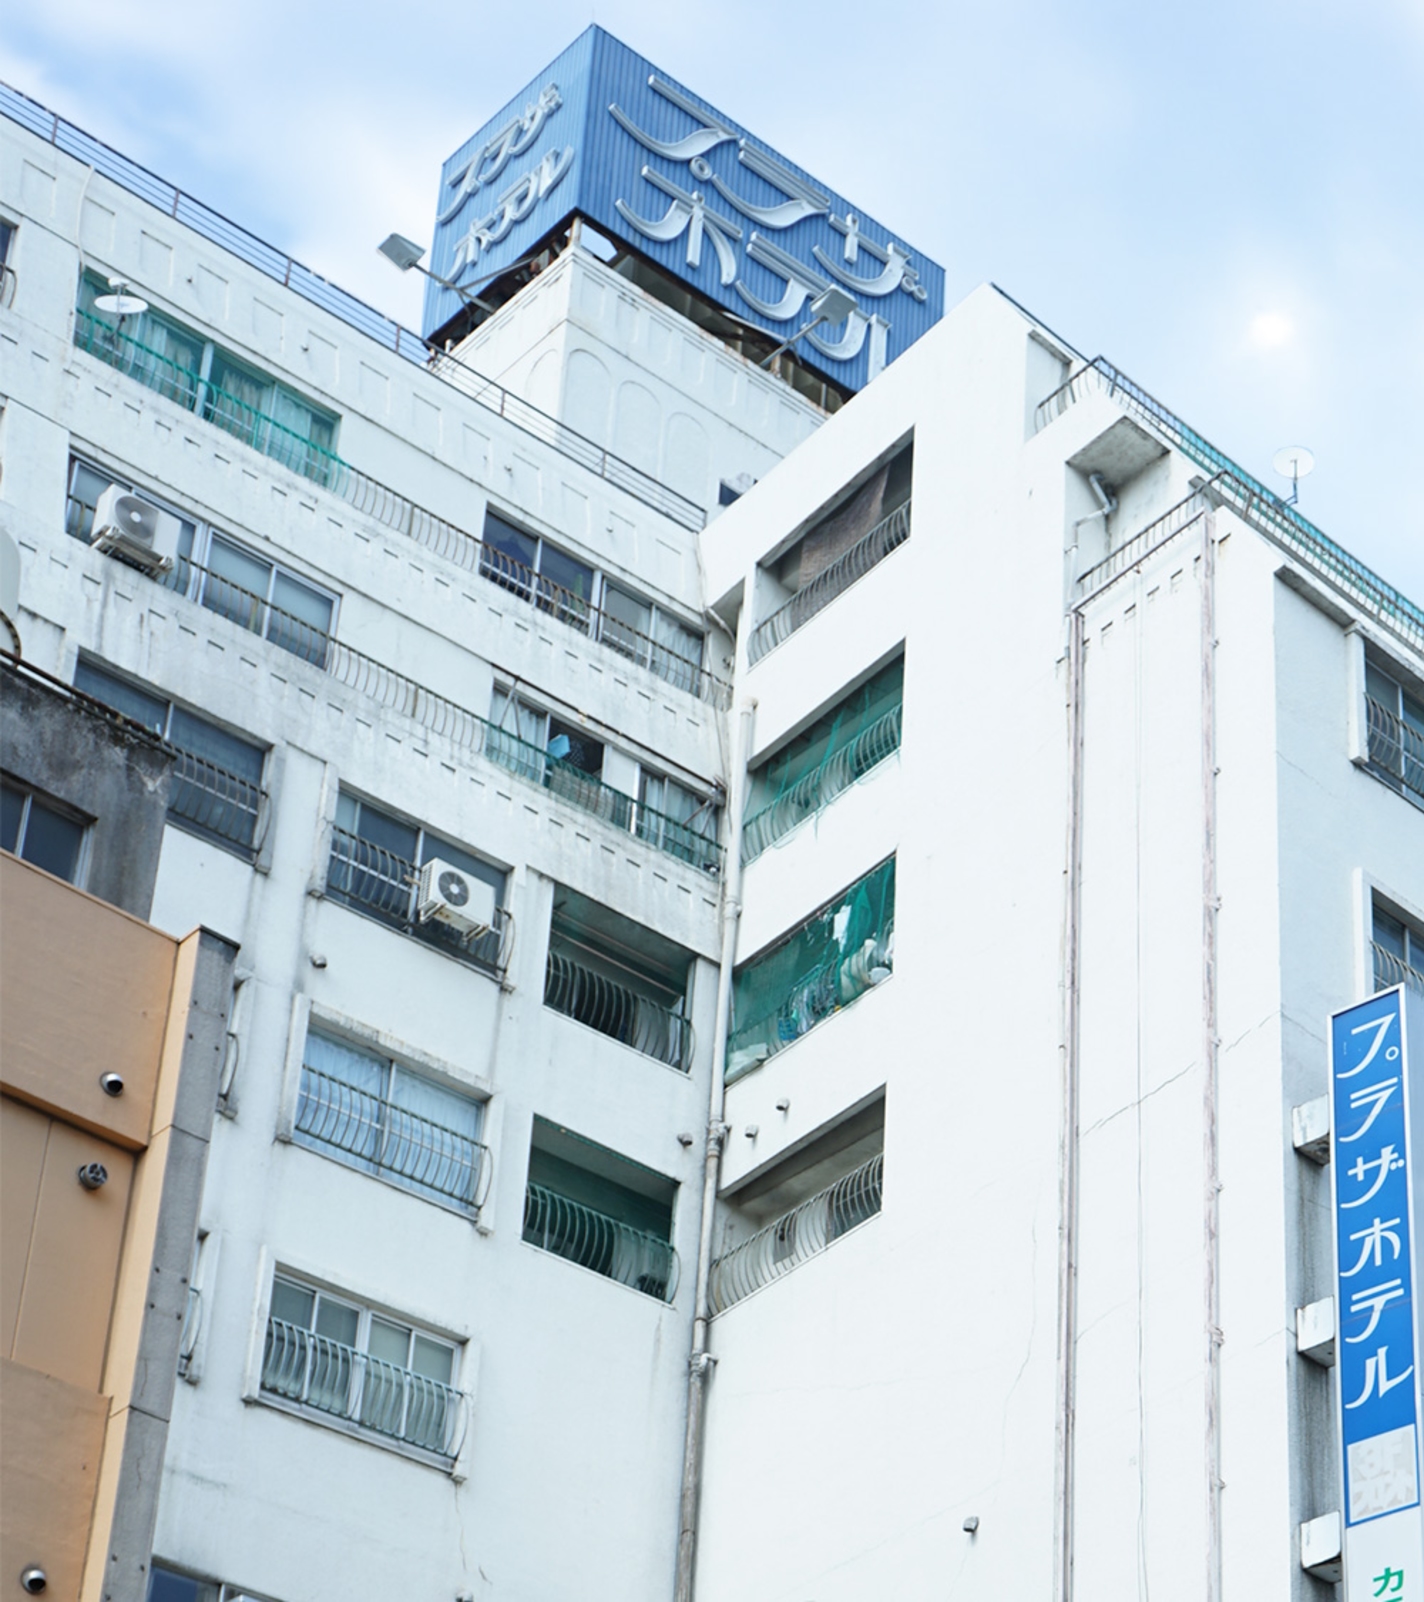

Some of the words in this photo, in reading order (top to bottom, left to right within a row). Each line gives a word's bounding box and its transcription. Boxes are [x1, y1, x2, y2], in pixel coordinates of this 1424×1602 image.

[607, 73, 928, 303] プラザ
[1335, 1012, 1415, 1410] プラザホテル
[1372, 1566, 1404, 1602] カ
